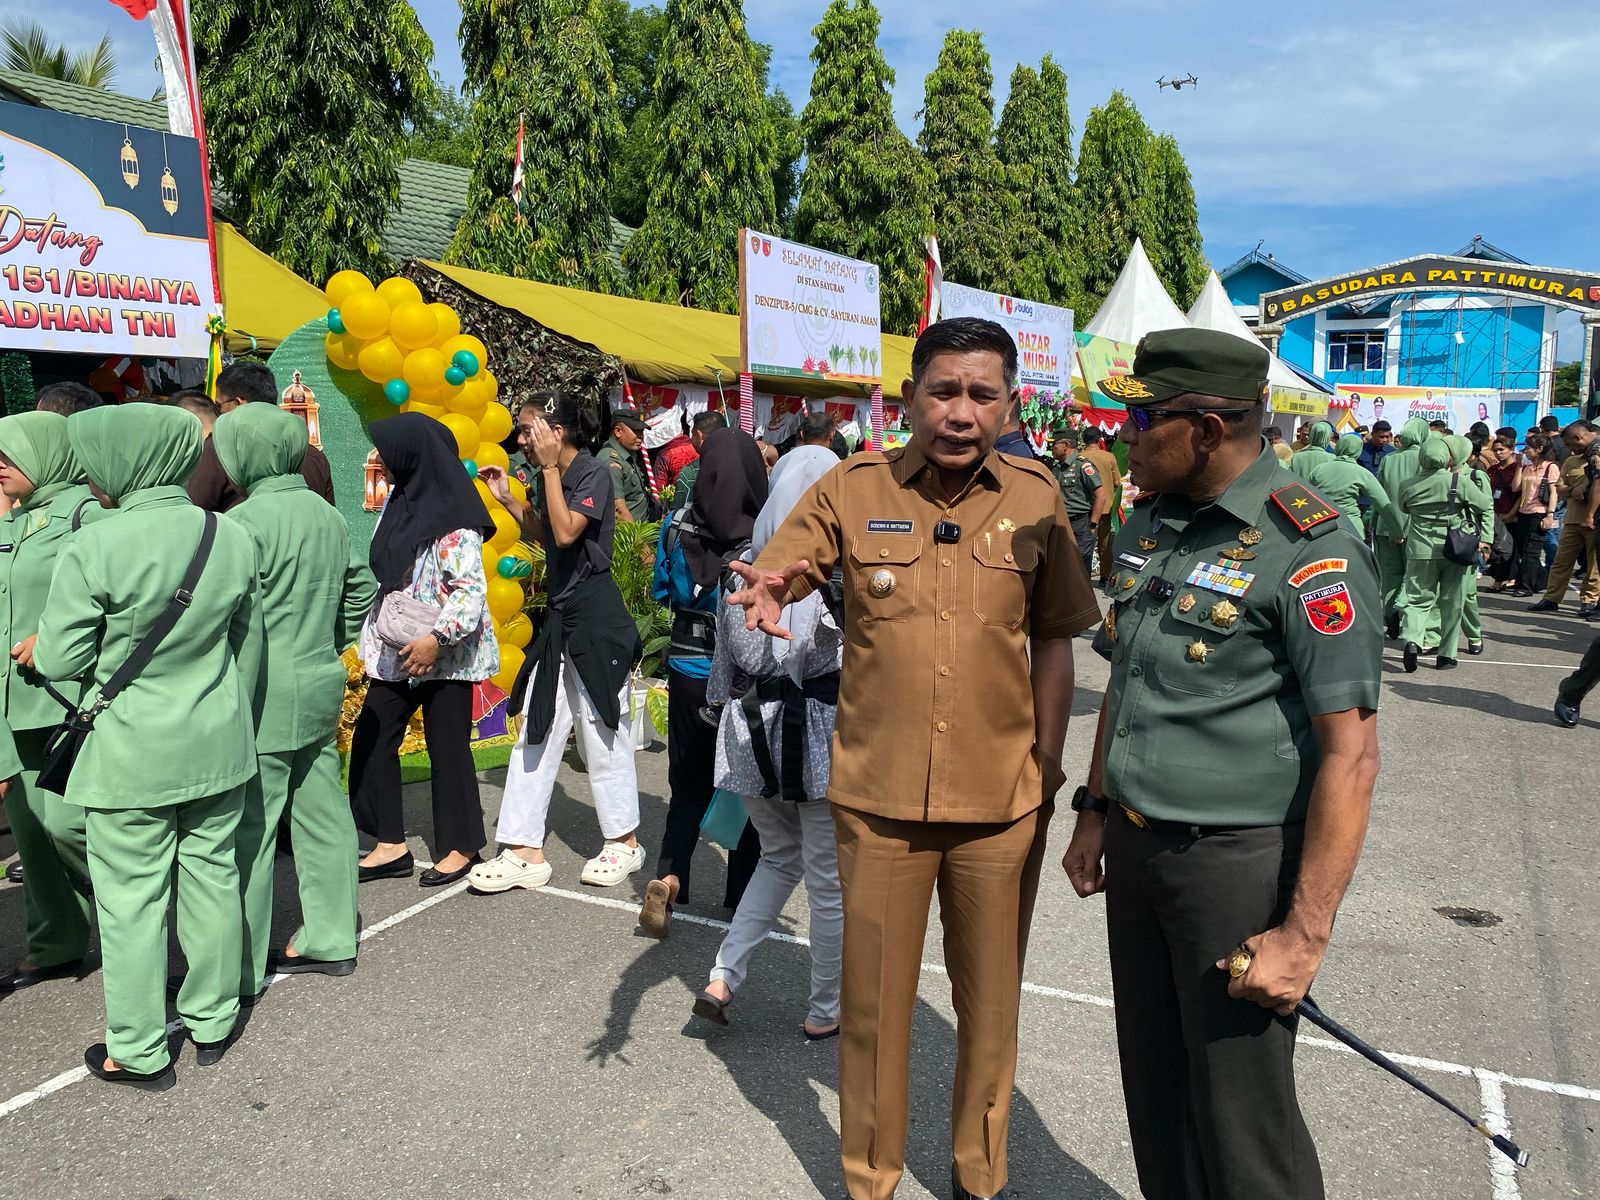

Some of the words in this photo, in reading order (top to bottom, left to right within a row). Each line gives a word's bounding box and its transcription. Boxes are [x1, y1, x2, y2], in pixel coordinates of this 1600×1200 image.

[0, 204, 104, 266] Datang
[782, 248, 822, 272] SELAMAT
[824, 260, 857, 283] DATANG
[2, 264, 201, 306] 151/BINAIYA
[797, 275, 804, 285] DI
[804, 277, 819, 289] STAN
[820, 280, 845, 293] SAYURAN
[1281, 271, 1416, 313] BASUDARA
[1427, 269, 1584, 301] PATTIMURA
[121, 308, 177, 338] TNI
[831, 309, 859, 323] SAYURAN
[860, 315, 878, 326] AMAN
[1017, 331, 1050, 353] BAZAR
[1023, 351, 1057, 372] MURAH
[1407, 410, 1449, 420] PANGAN
[1409, 399, 1447, 411] Gerakan
[1302, 510, 1330, 524] TNI
[1303, 585, 1344, 601] PATTIMURA
